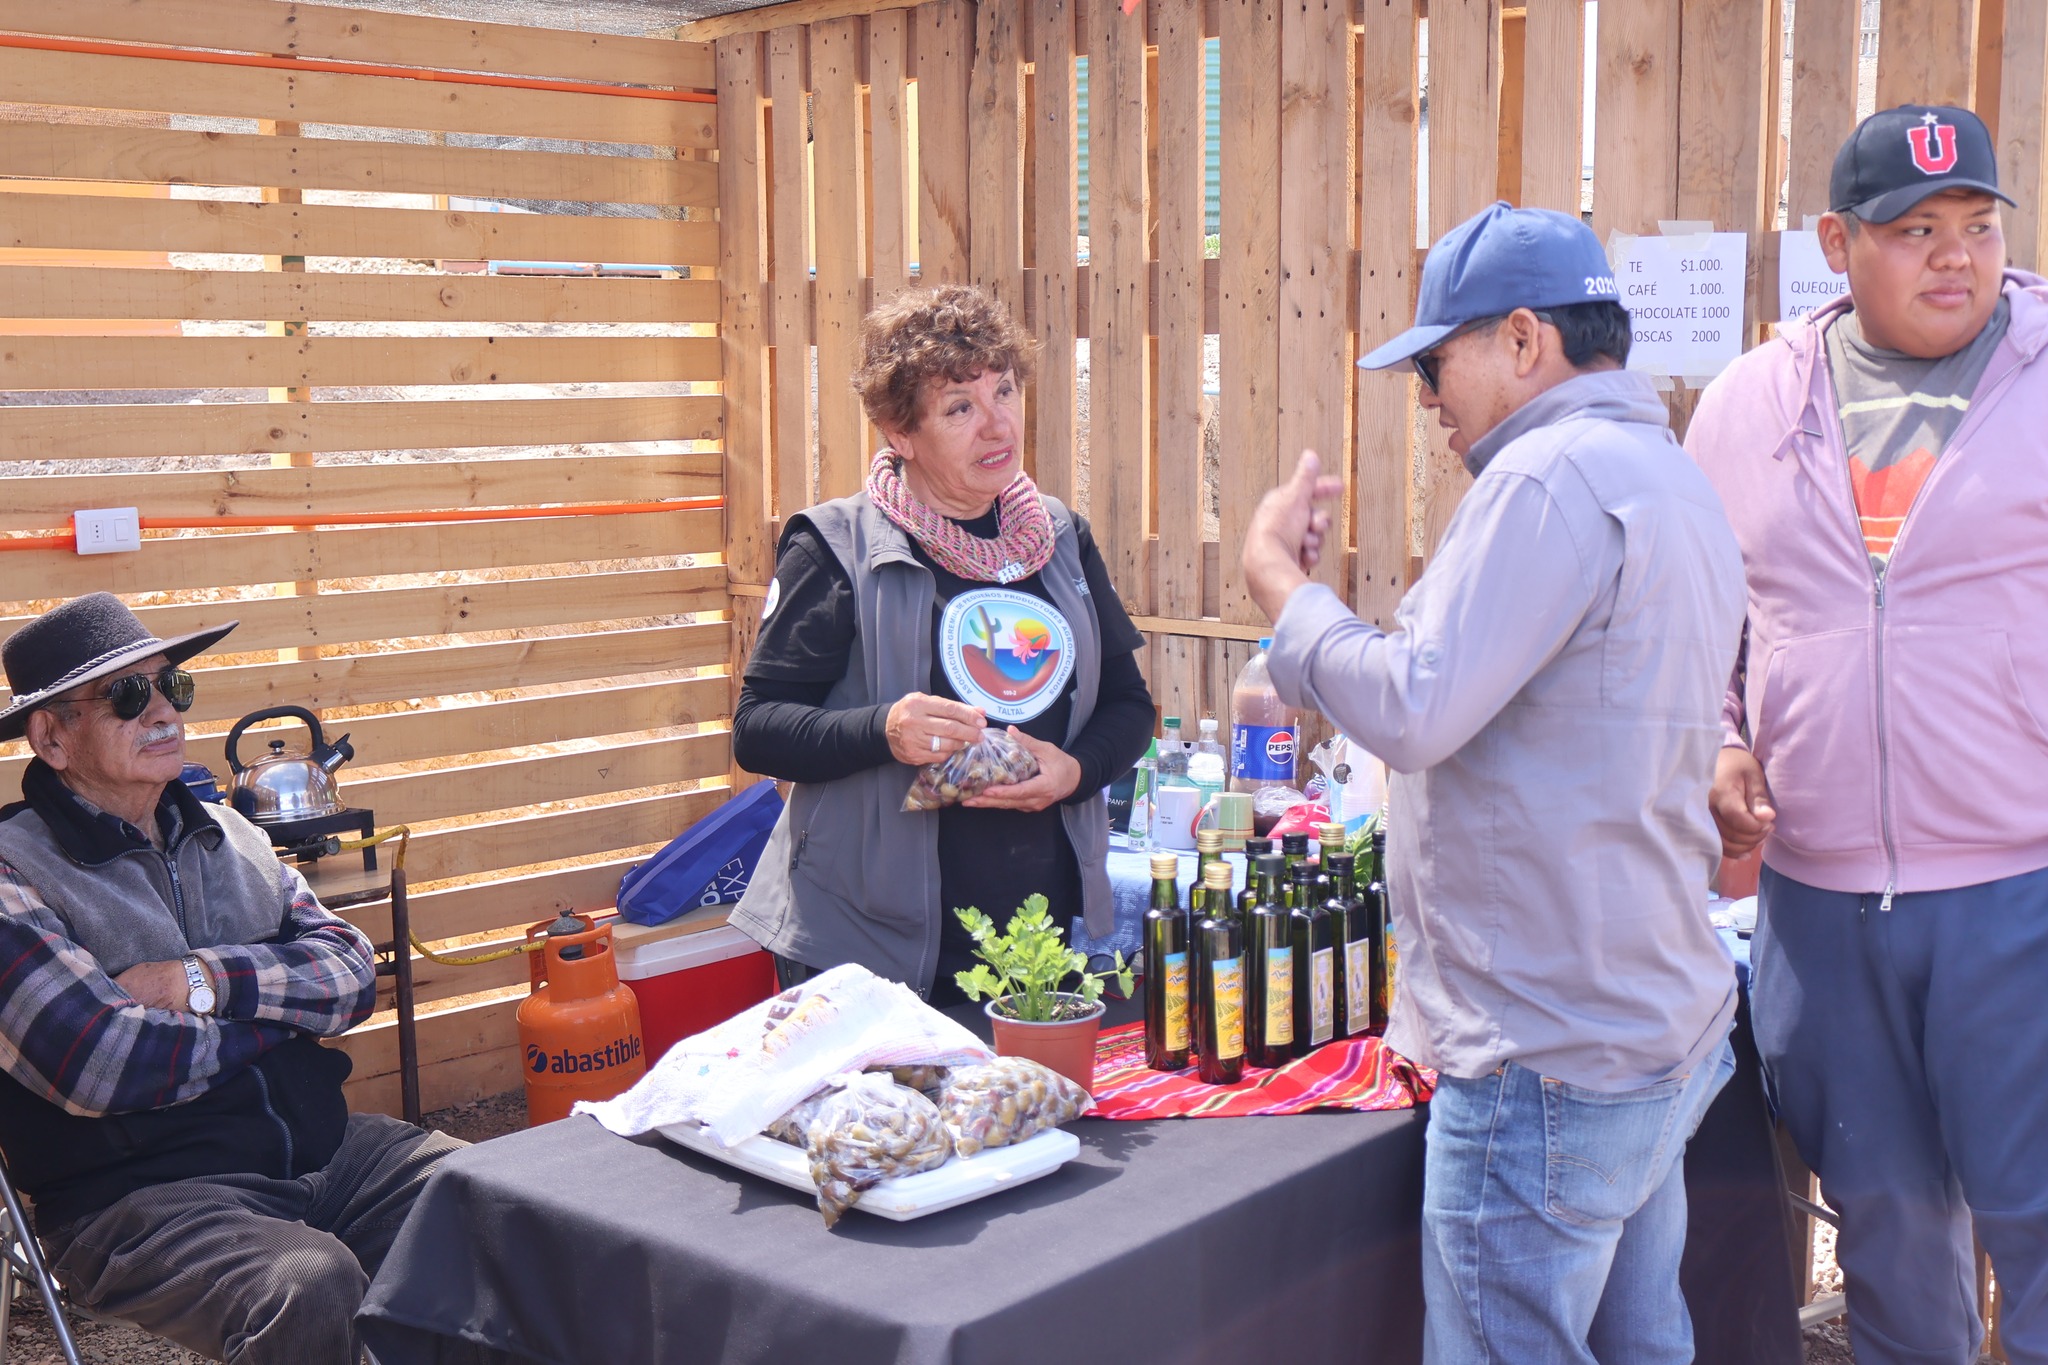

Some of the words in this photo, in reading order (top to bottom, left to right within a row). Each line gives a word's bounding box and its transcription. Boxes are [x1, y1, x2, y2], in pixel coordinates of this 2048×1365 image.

[1906, 124, 1958, 175] U
[1629, 261, 1643, 273] TE
[1680, 259, 1723, 273] $1.000.
[1628, 281, 1657, 296] CAFÉ
[1689, 283, 1725, 295] 1.000.
[1790, 280, 1847, 295] QUEQUE
[1702, 306, 1730, 319] 1000
[1632, 330, 1673, 343] OSCAS
[1691, 330, 1721, 343] 2000
[1004, 593, 1064, 624] PRODUCTORES
[997, 705, 1025, 716] TALTAL
[551, 1034, 641, 1074] abastible
